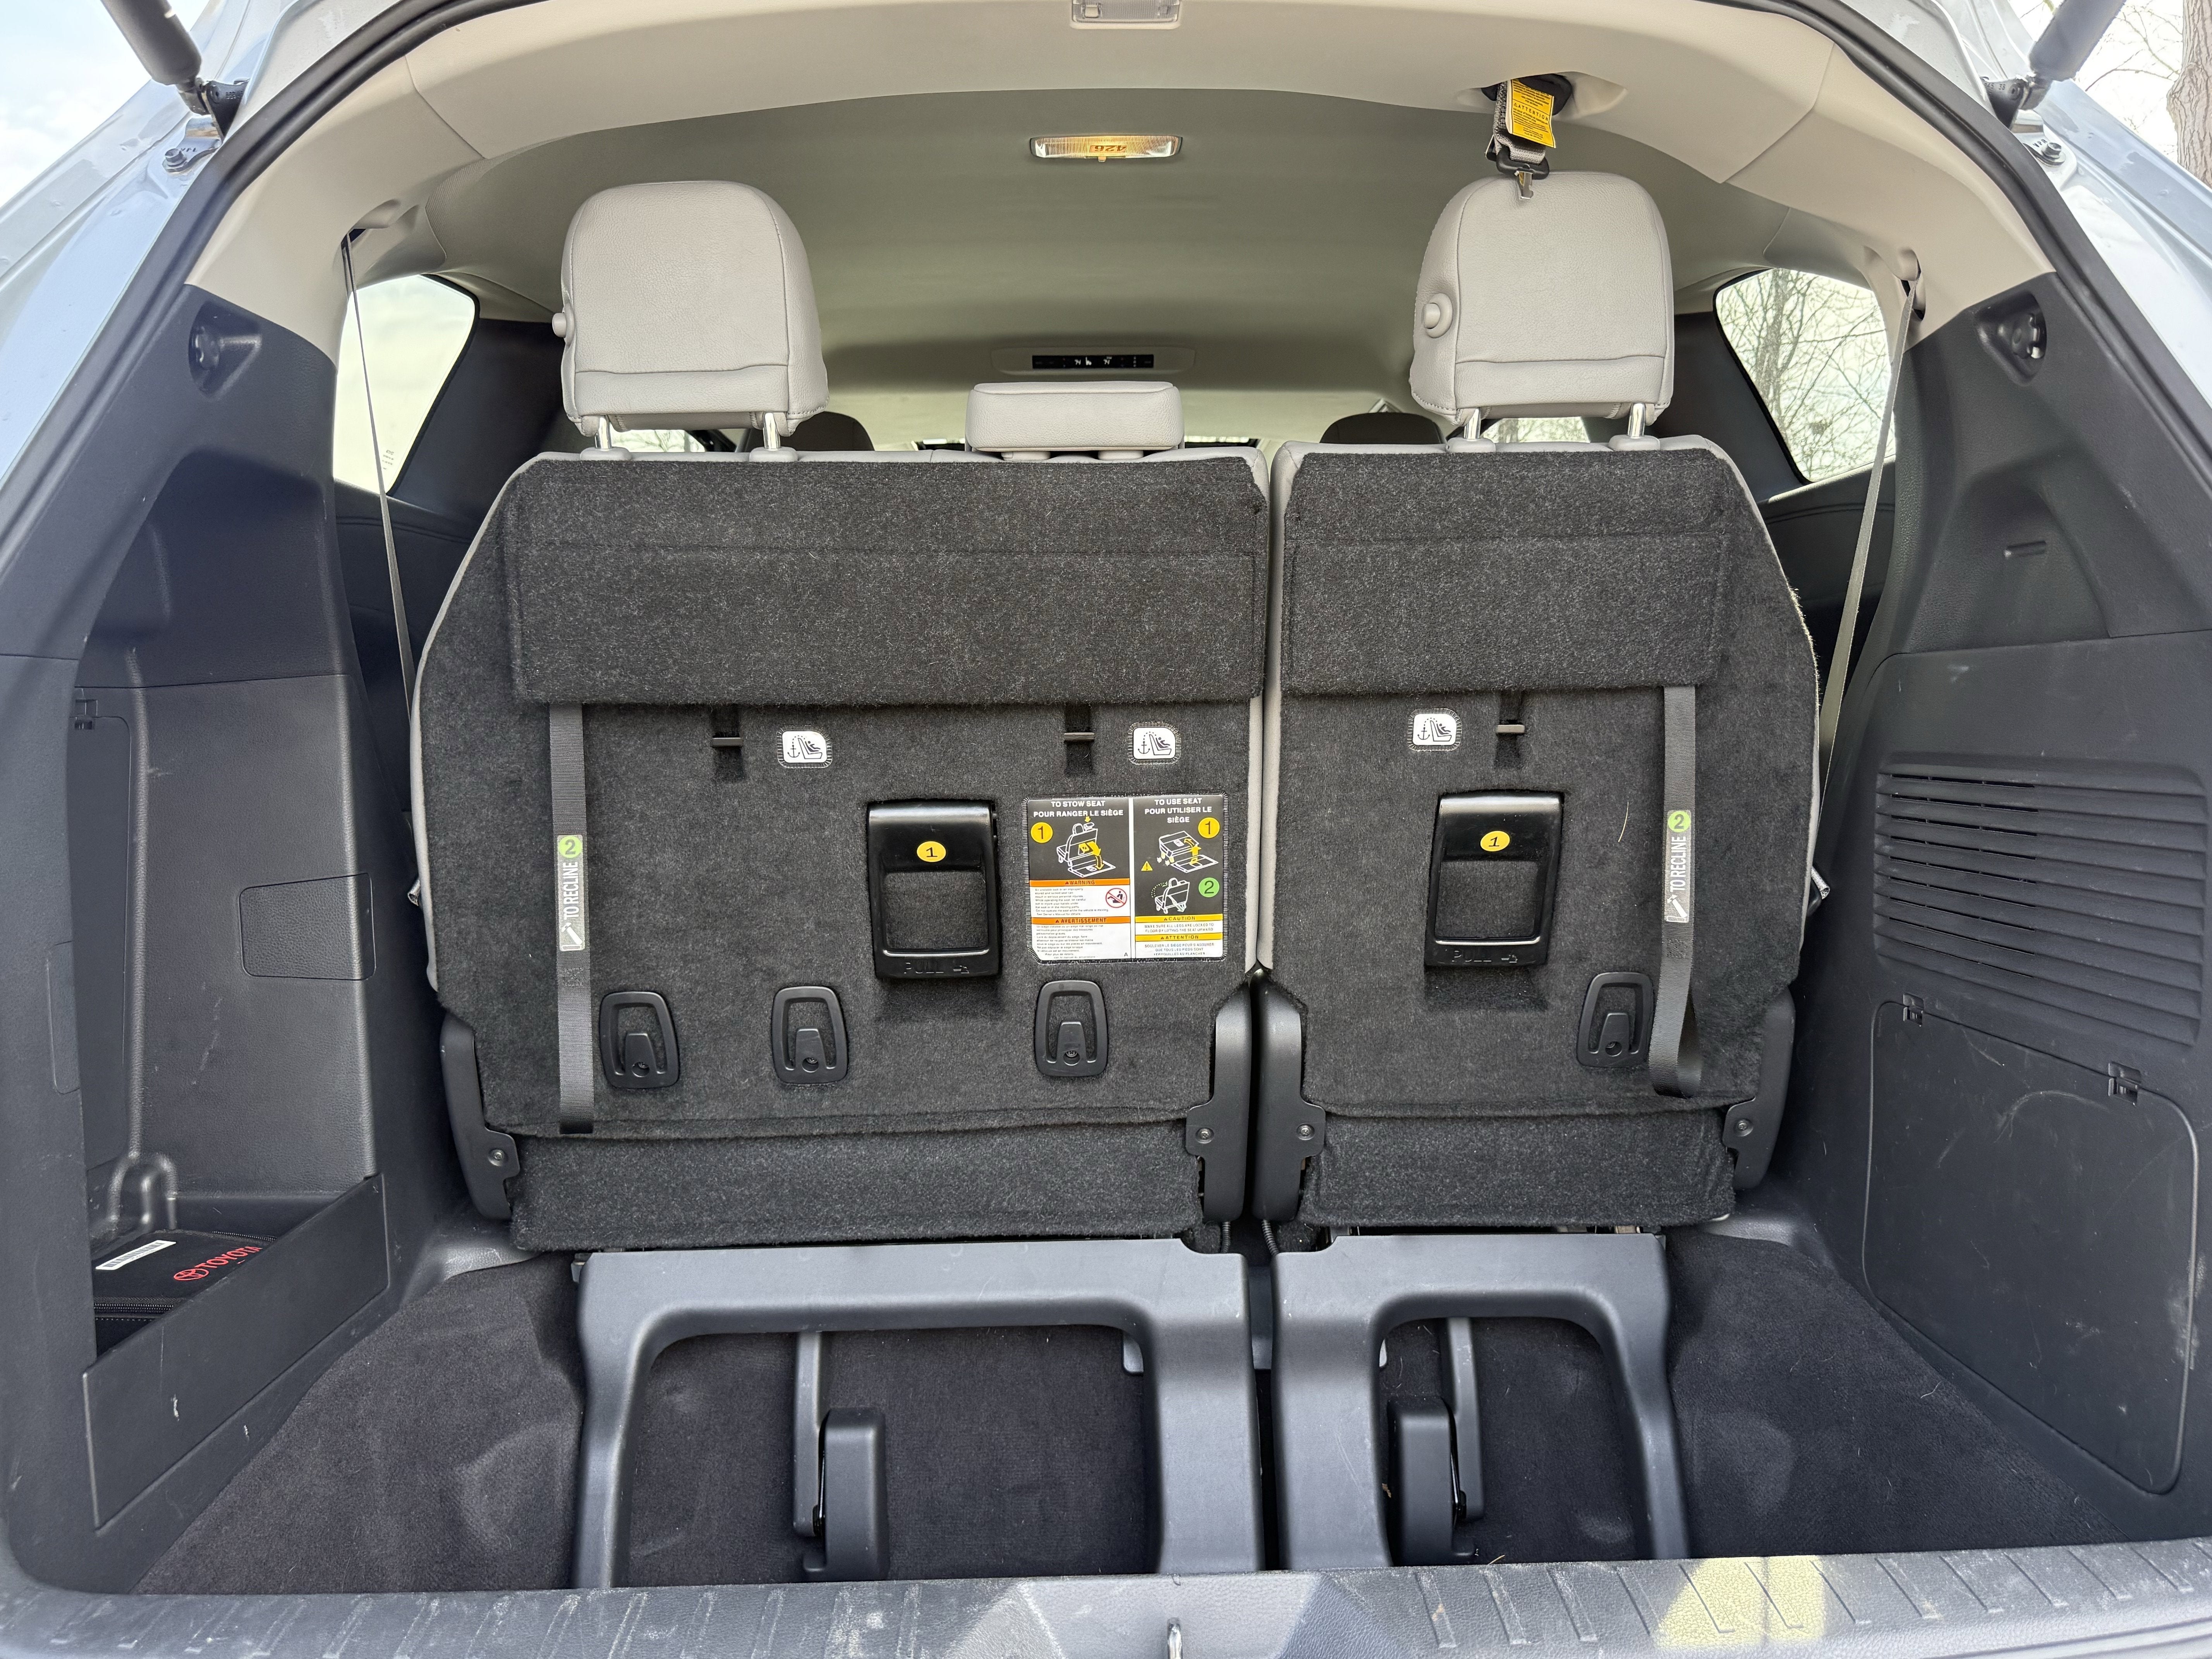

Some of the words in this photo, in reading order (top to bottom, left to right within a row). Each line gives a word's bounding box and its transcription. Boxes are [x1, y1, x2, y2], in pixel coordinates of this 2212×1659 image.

[1518, 105, 1548, 121] ATTENTION
[1205, 821, 1211, 835] 1
[1674, 814, 1685, 830] 2
[1038, 826, 1044, 839] 1
[565, 839, 576, 855] 2
[1488, 836, 1500, 847] 1
[926, 847, 938, 857] 1
[1670, 836, 1686, 877] RECLINE
[563, 862, 579, 904] RECLINE
[1204, 880, 1214, 894] 2
[1670, 879, 1686, 892] TO
[564, 906, 579, 920] TO
[194, 1246, 263, 1268] TOYOTA
